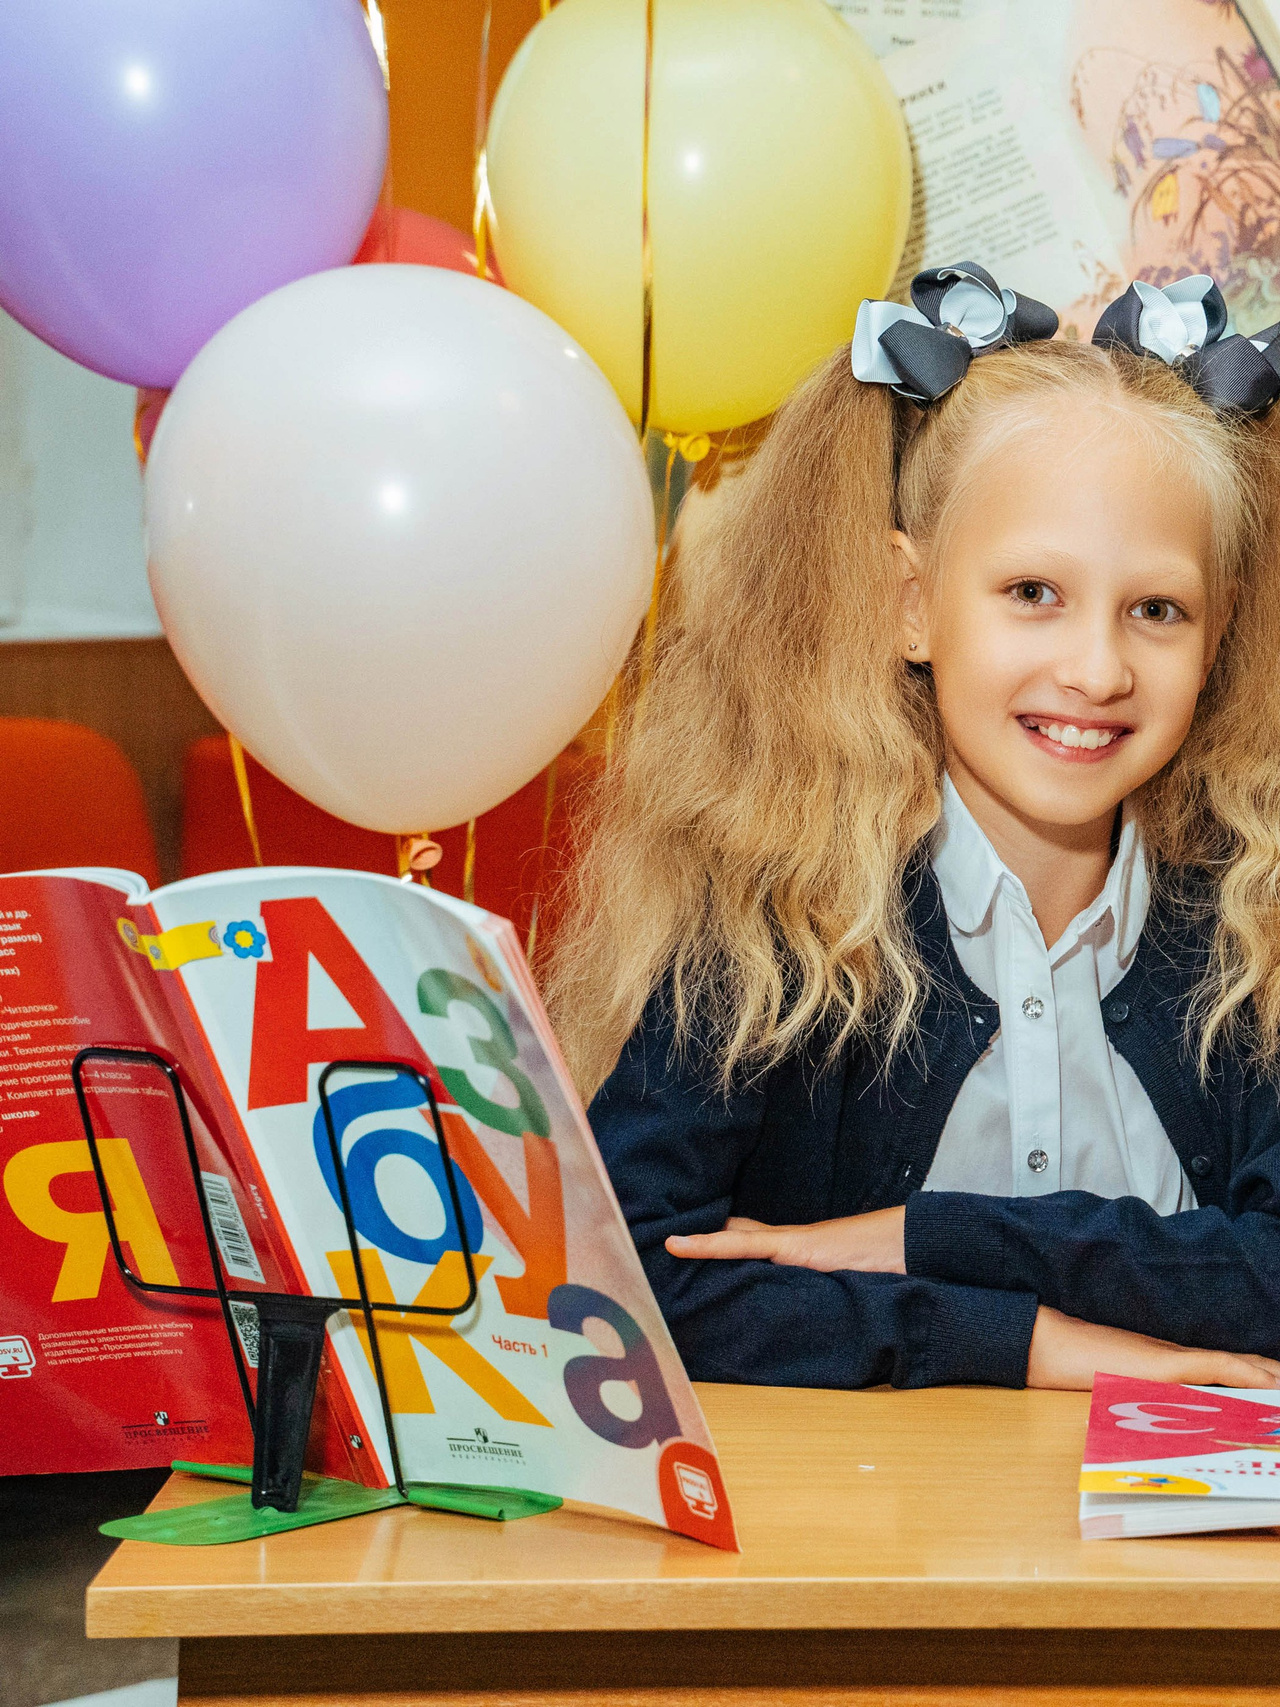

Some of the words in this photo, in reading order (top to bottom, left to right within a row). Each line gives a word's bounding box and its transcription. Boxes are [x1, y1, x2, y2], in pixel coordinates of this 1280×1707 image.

[53, 1015, 91, 1025] пособие
[7, 1089, 53, 1100] Комплект
[249, 1184, 268, 1219] Азбука
[38, 1328, 106, 1341] Дополнительные
[108, 1324, 152, 1334] материалы
[159, 1322, 193, 1330] учебнику
[41, 1339, 89, 1350] размещены
[97, 1332, 149, 1343] электронном
[150, 1331, 184, 1339] каталоге
[492, 1334, 537, 1355] Часть
[541, 1344, 548, 1358] 1
[44, 1345, 99, 1357] издательства
[59, 1352, 132, 1364] интернет-ресурсе
[133, 1348, 183, 1358] www.prosv.ru
[449, 1443, 524, 1458] ПРОСВЕЩЕНИЕ
